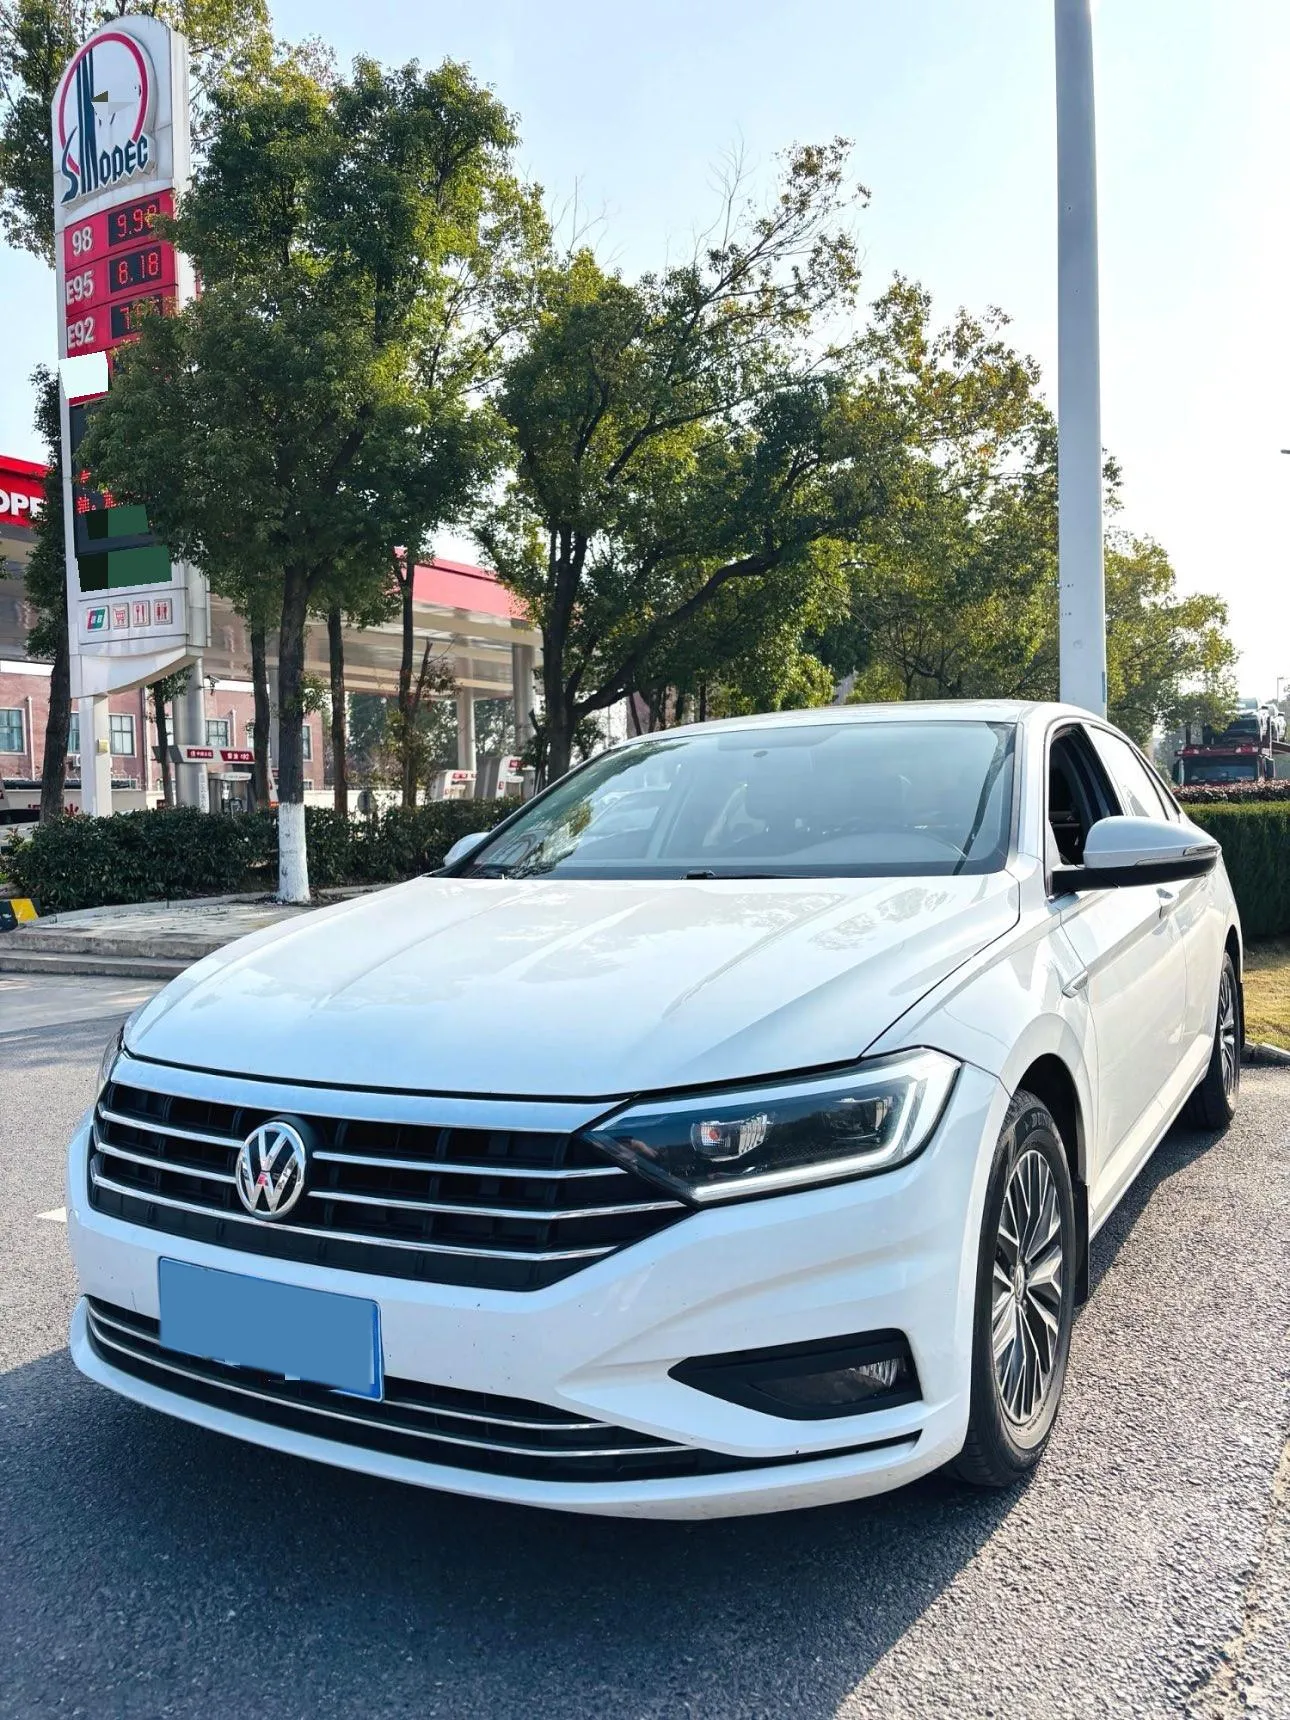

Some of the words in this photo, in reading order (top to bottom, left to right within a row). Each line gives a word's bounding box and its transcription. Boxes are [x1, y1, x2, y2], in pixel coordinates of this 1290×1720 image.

[72, 226, 93, 257] 98
[66, 270, 95, 305] E95
[118, 252, 159, 285] 8.18
[67, 316, 95, 349] E92
